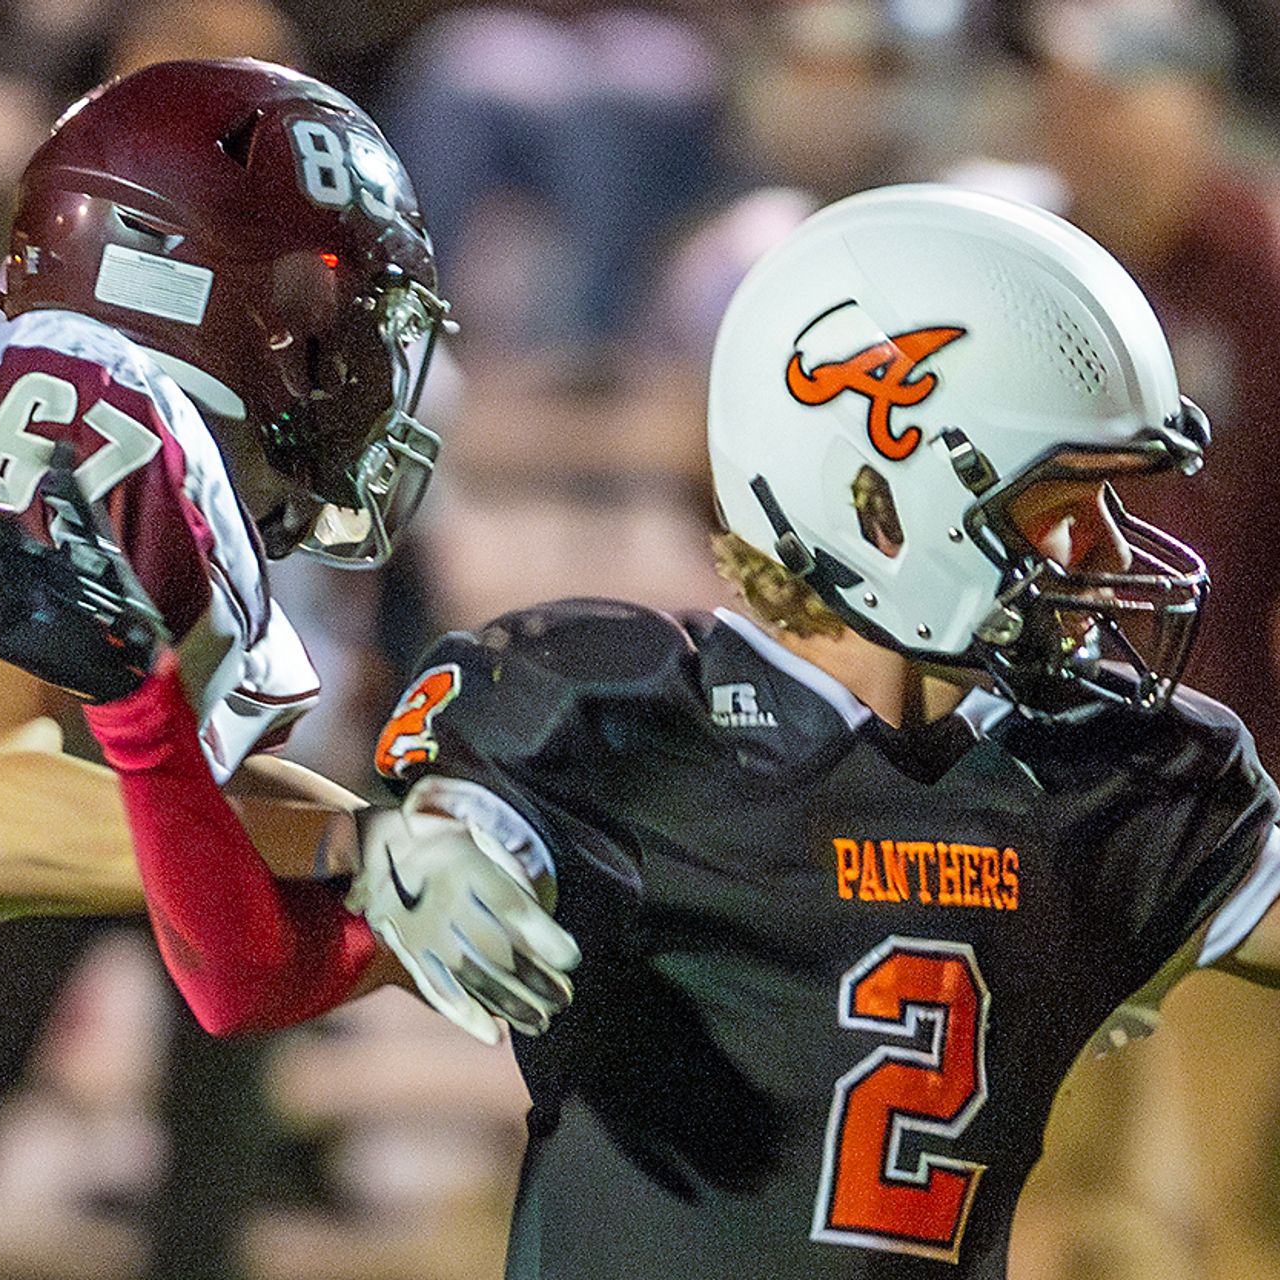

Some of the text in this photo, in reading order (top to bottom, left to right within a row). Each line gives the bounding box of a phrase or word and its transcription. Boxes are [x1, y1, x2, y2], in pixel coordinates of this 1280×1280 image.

[374, 662, 462, 779] 2
[833, 837, 1019, 911] PANTHERS
[810, 934, 992, 1266] 2
